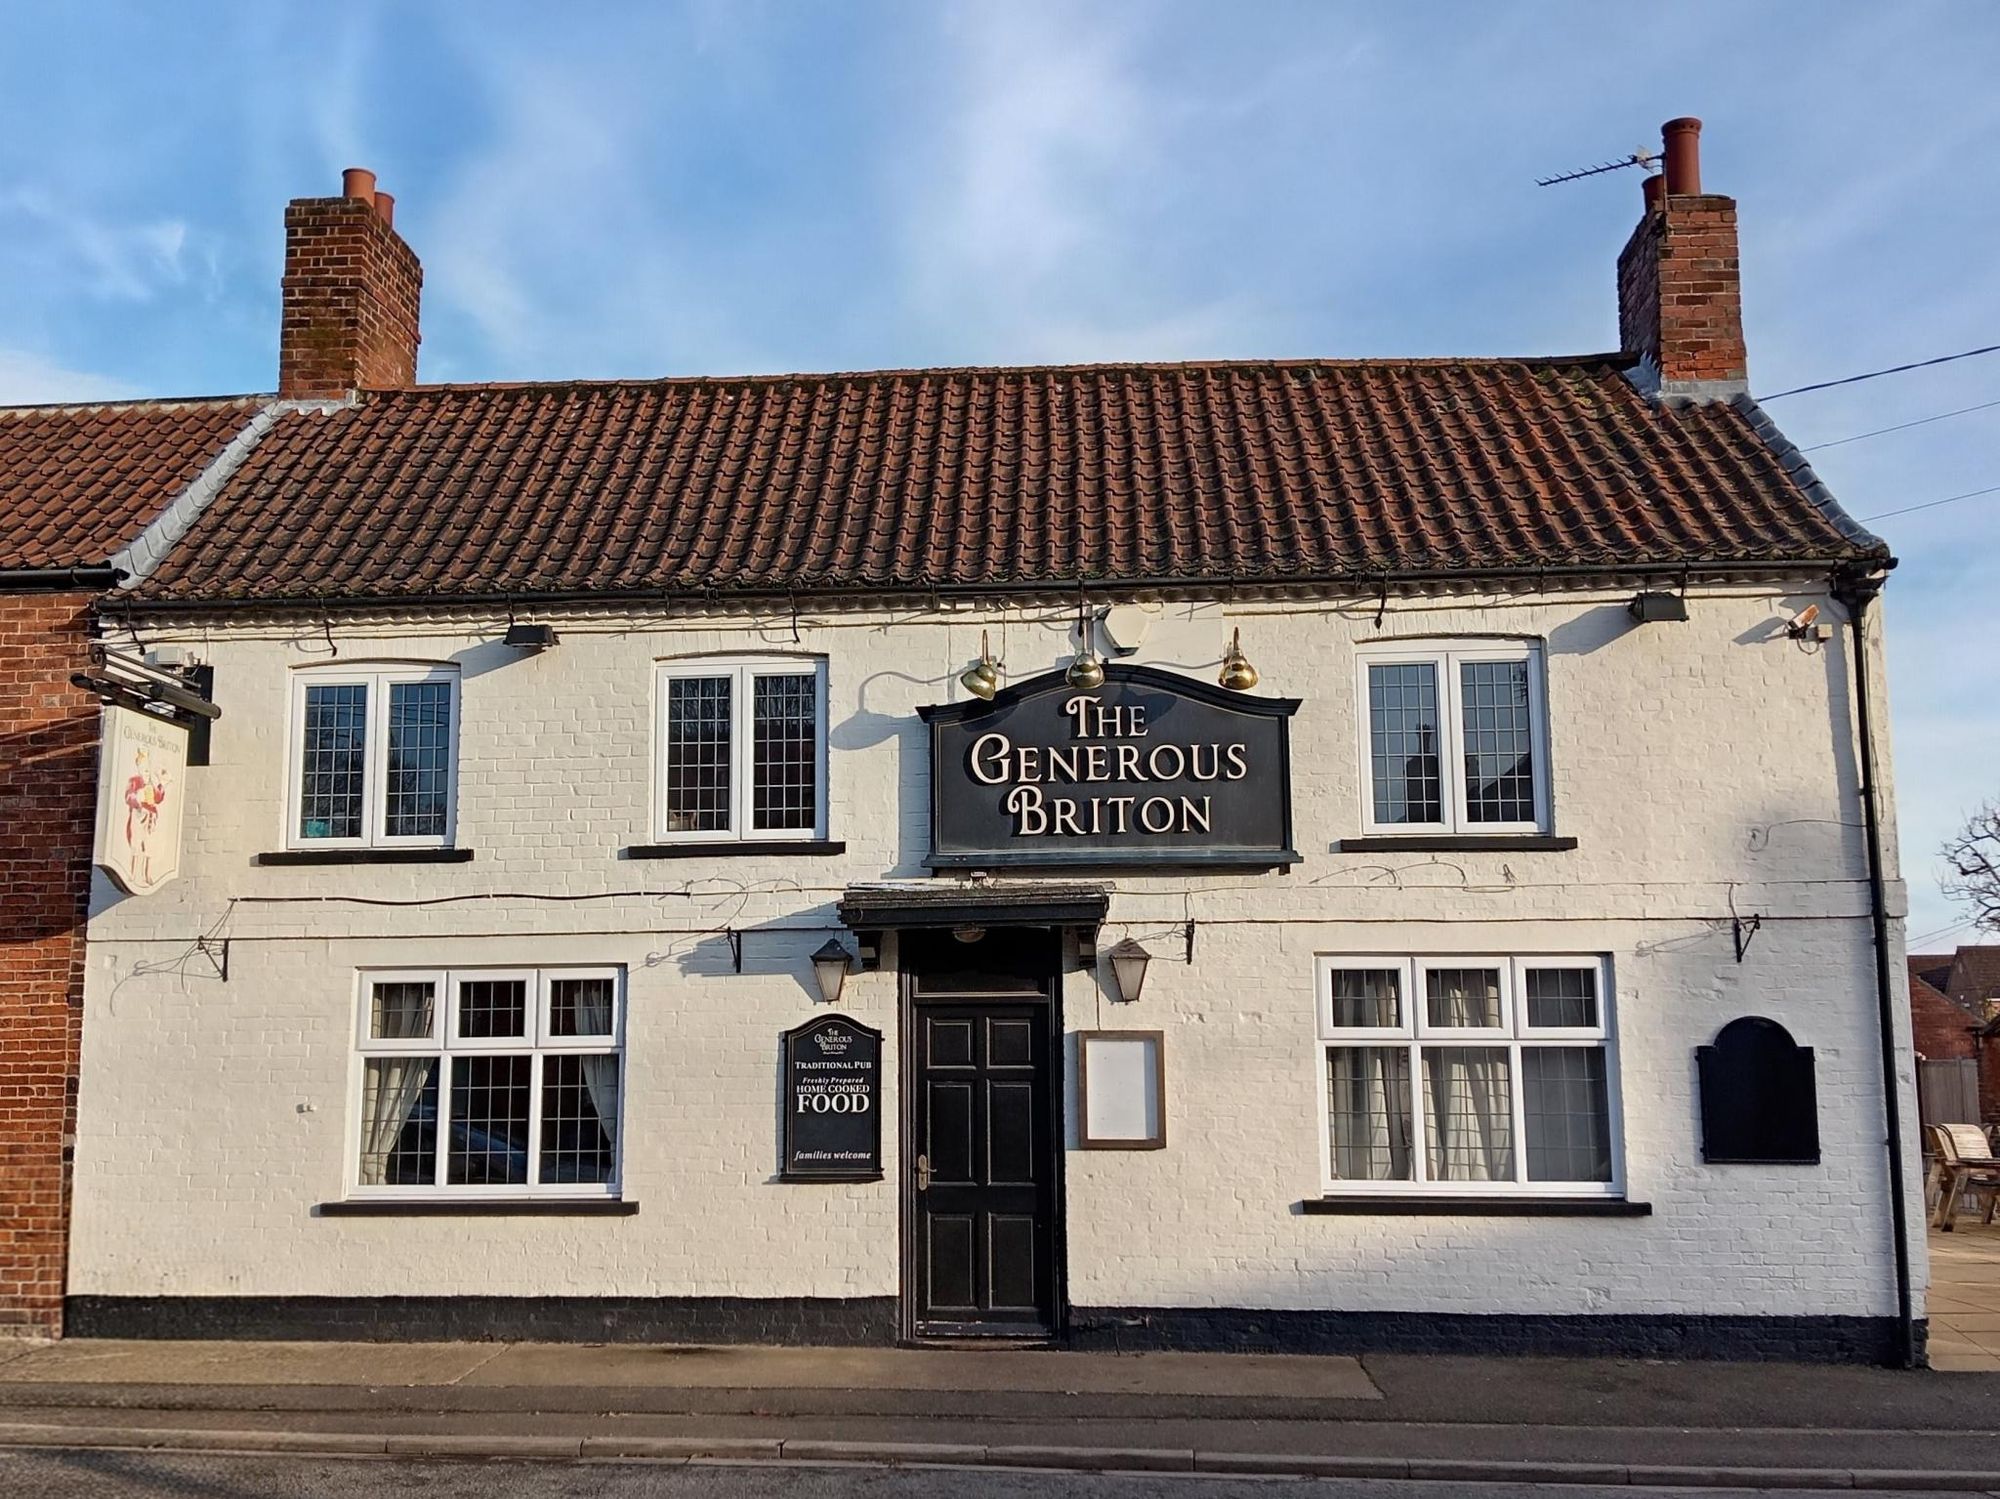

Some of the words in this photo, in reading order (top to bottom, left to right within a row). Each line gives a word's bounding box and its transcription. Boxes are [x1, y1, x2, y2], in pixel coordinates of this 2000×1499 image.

[1066, 695, 1149, 738] THE
[971, 733, 1248, 784] GENEROUS
[1007, 785, 1211, 835] BRITON
[795, 1061, 853, 1069] TRADITIONAL
[854, 1061, 872, 1069] PUB
[796, 1084, 827, 1094] HOME
[828, 1084, 870, 1094] COOKED
[802, 1077, 829, 1085] Freshly
[830, 1077, 864, 1085] Prepared
[796, 1093, 870, 1114] FOOD
[793, 1150, 832, 1162] families
[833, 1150, 872, 1160] welcome
